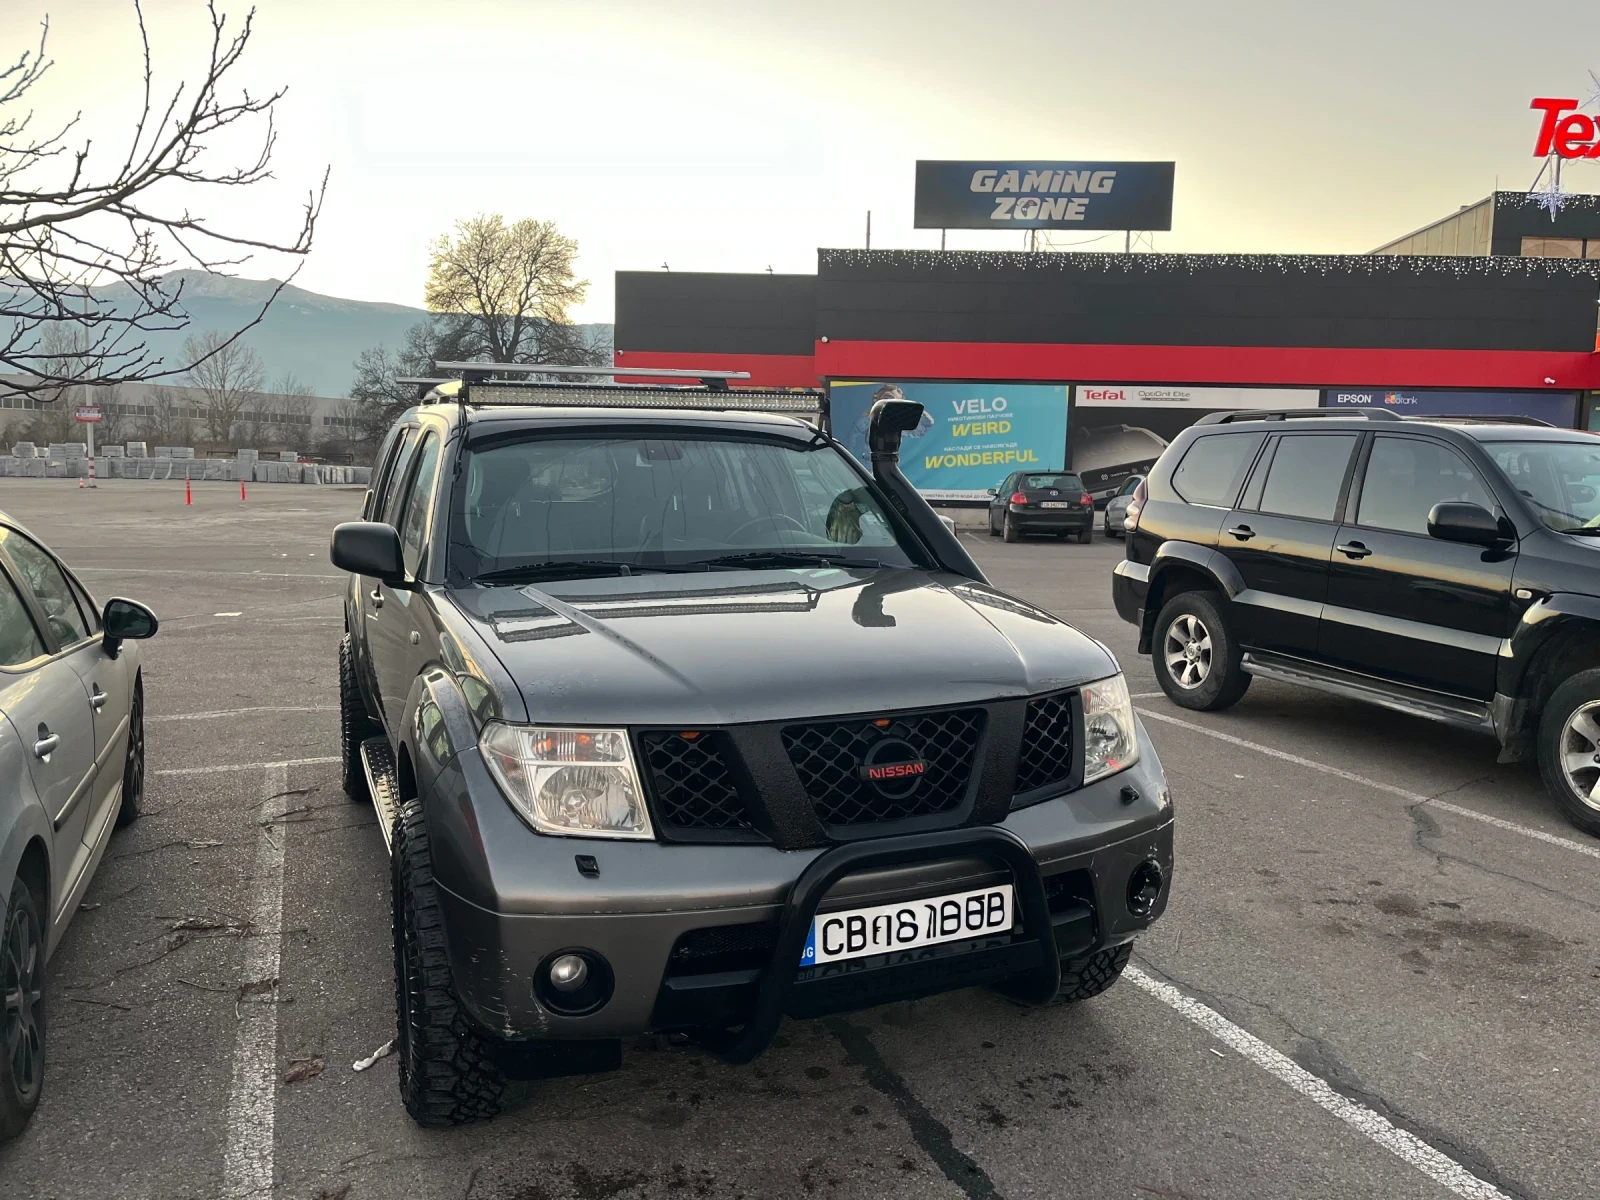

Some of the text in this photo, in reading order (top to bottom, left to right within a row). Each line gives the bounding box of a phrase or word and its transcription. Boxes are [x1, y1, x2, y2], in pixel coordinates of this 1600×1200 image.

[970, 169, 1117, 194] GAMING
[990, 197, 1090, 221] ZONE
[1083, 389, 1127, 401] Tefal
[1337, 394, 1372, 404] EPSON
[952, 397, 1008, 415] VELO
[952, 420, 1011, 437] WEIRD
[925, 449, 1039, 469] WONDERFUL
[869, 763, 924, 779] NISSAN
